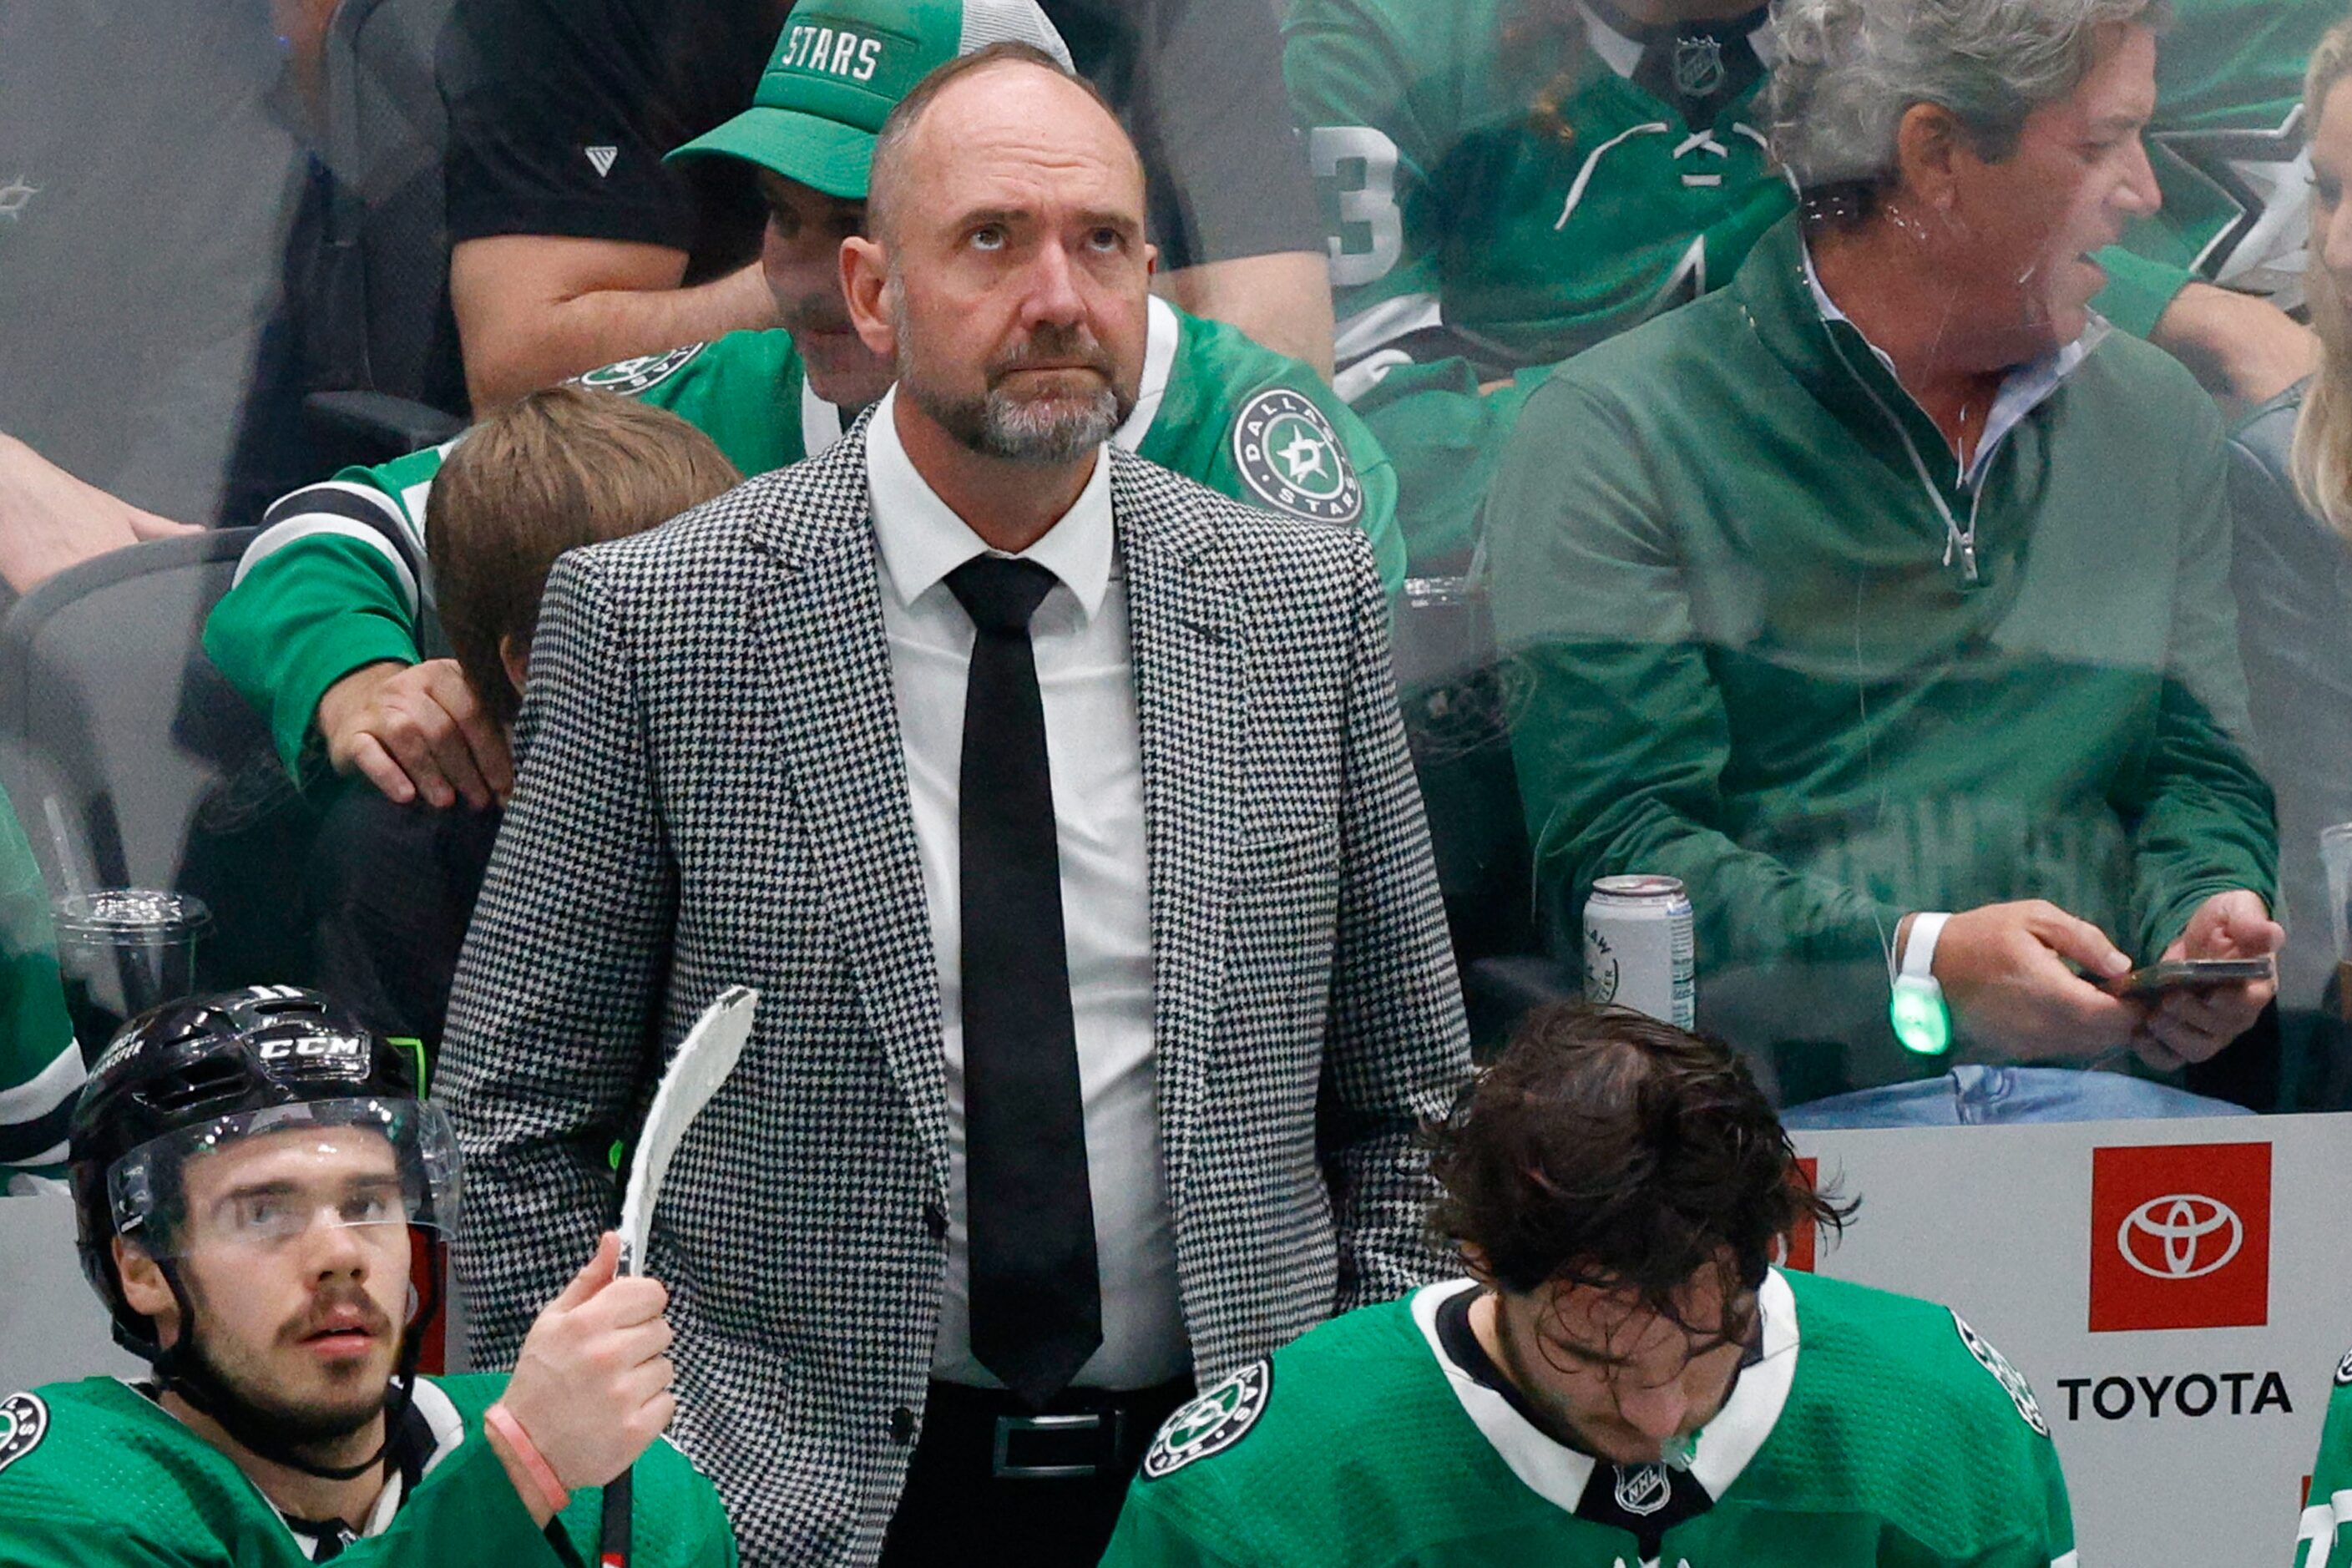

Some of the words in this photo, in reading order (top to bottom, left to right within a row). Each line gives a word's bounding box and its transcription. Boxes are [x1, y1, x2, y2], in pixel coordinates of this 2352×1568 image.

[781, 26, 882, 81] STARS
[1309, 126, 1402, 286] 3
[259, 1036, 360, 1060] CCM
[2056, 1372, 2293, 1420] TOYOTA
[1629, 1469, 1658, 1502] NHL
